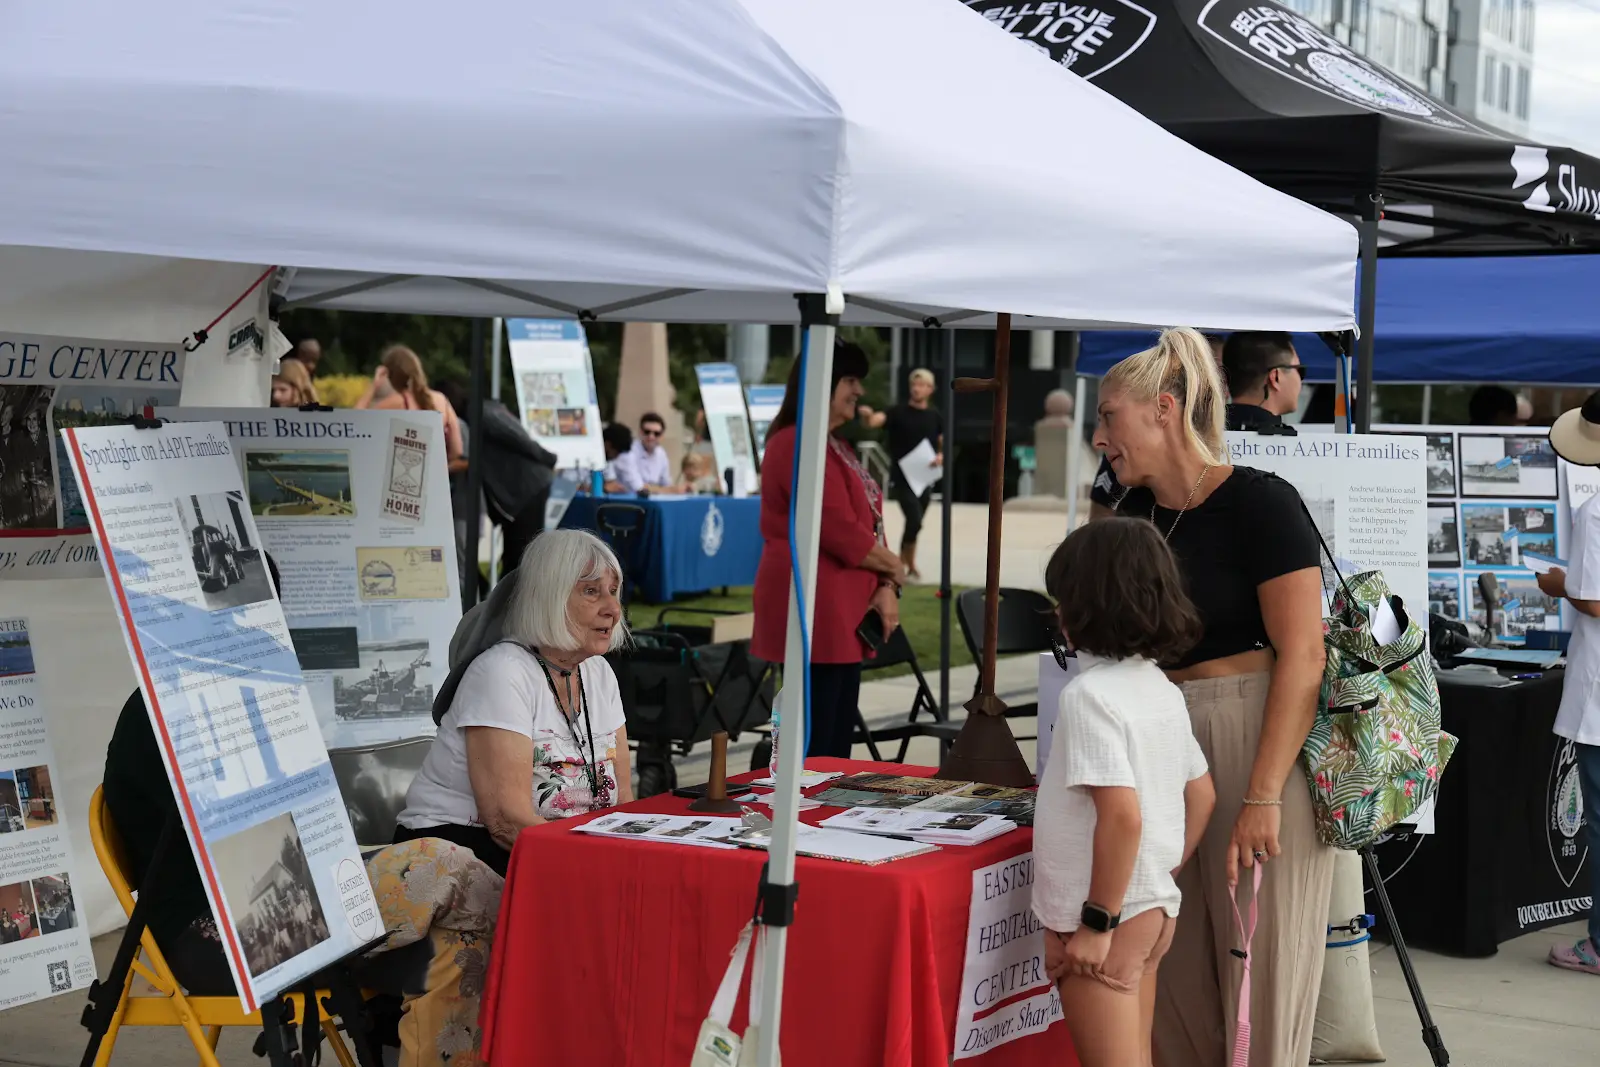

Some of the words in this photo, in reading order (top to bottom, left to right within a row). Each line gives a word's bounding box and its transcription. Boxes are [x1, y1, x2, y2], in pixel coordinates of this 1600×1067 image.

[981, 2, 1116, 27] ELLEVUE
[989, 15, 1114, 56] LICE
[49, 345, 180, 382] CENTER
[223, 420, 267, 438] THE
[274, 418, 372, 439] BRIDGE...
[405, 428, 418, 439] 15
[82, 438, 141, 473] Spotlight
[143, 445, 157, 461] on
[157, 436, 188, 459] AAPI
[187, 433, 230, 457] Families
[393, 436, 427, 451] MINUTES
[1265, 444, 1287, 457] on
[1292, 441, 1340, 458] AAPI
[1346, 442, 1420, 460] Families
[1348, 485, 1375, 493] Andrew
[1403, 486, 1416, 494] and
[386, 498, 420, 515] HOME
[1361, 516, 1398, 526] Philippines
[1398, 517, 1408, 525] by
[1391, 527, 1408, 537] They
[26, 540, 66, 566] and
[1349, 547, 1375, 555] railroad
[1375, 549, 1418, 557] maintenance
[1368, 558, 1380, 566] but
[1397, 560, 1420, 568] turned
[18, 695, 34, 708] Do
[1561, 845, 1577, 857] 1953
[339, 874, 365, 895] EASTSIDE
[984, 857, 1035, 901] EASTSI
[343, 889, 371, 912] HERITAGE
[352, 908, 375, 928] CENTER
[974, 956, 1042, 1006] CENTER
[961, 1017, 1014, 1051] Discover.
[1017, 1004, 1049, 1031] Shar
